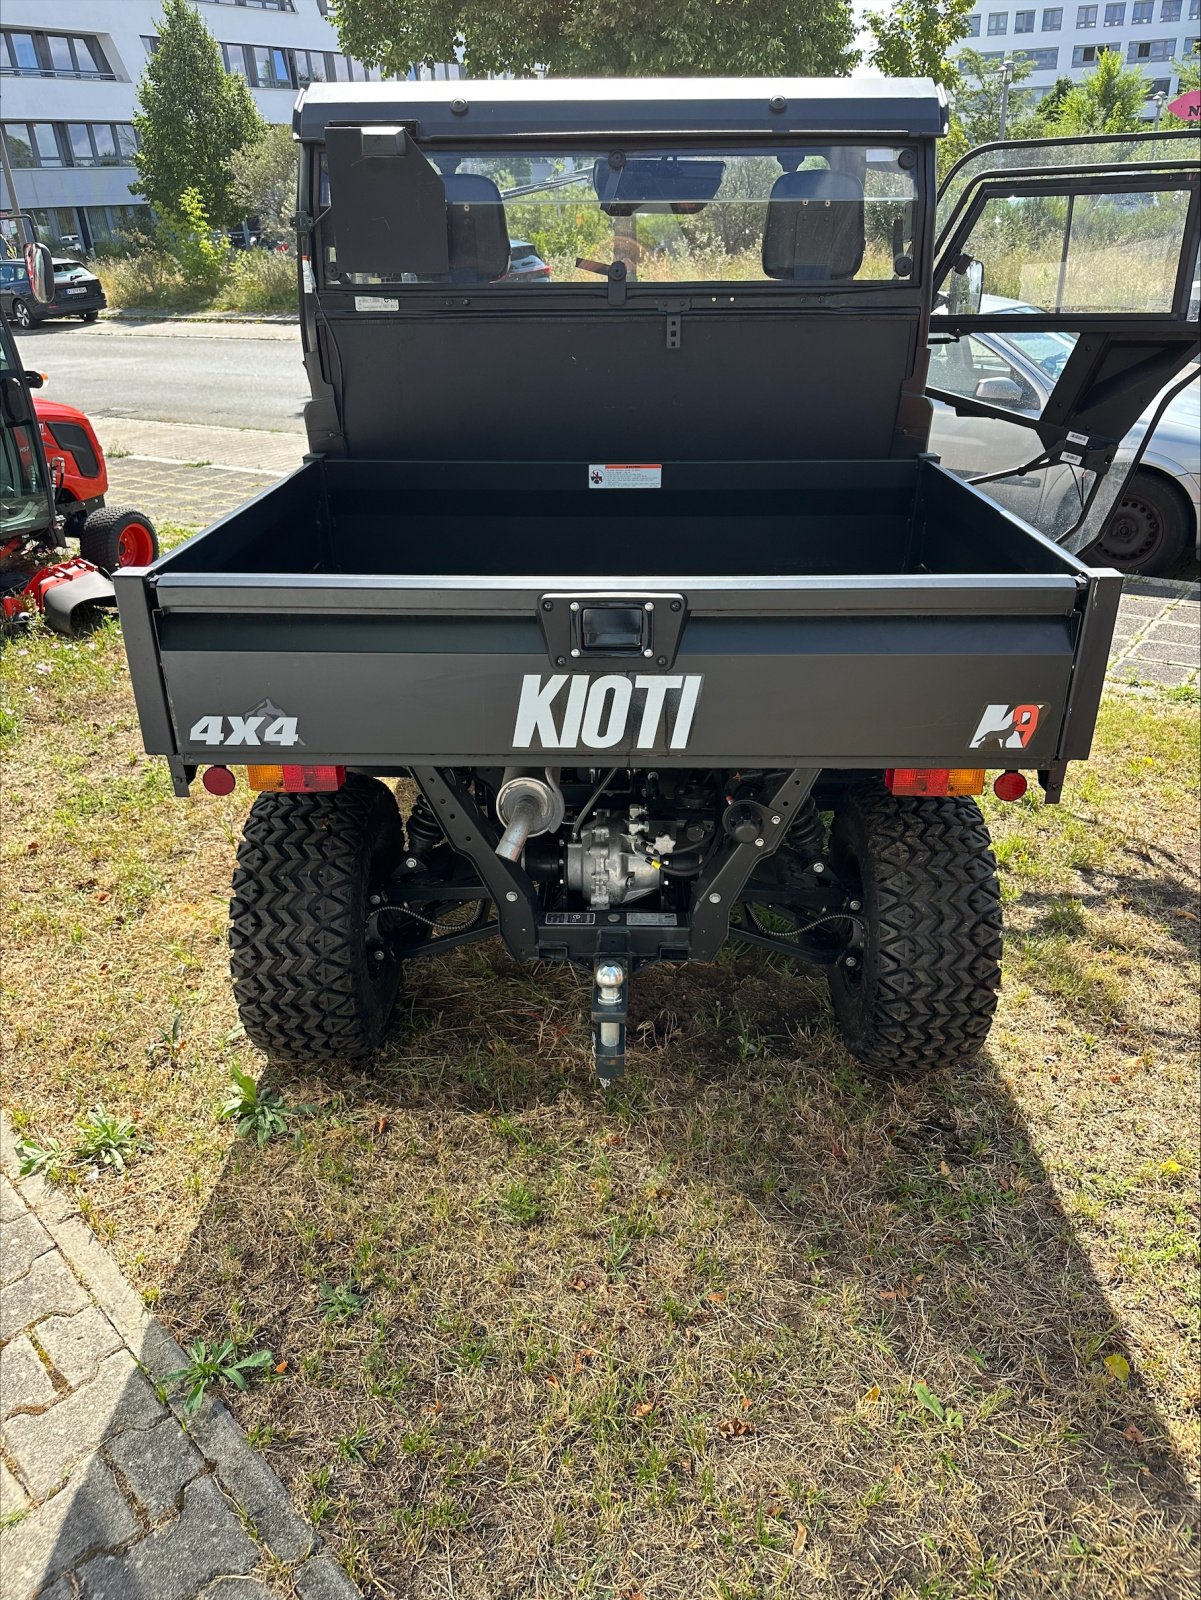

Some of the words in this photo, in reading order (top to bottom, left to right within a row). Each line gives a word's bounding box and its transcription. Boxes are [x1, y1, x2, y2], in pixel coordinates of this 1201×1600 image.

[189, 715, 299, 746] 4X4
[512, 674, 702, 749] KIOTI
[969, 704, 1045, 749] K9
